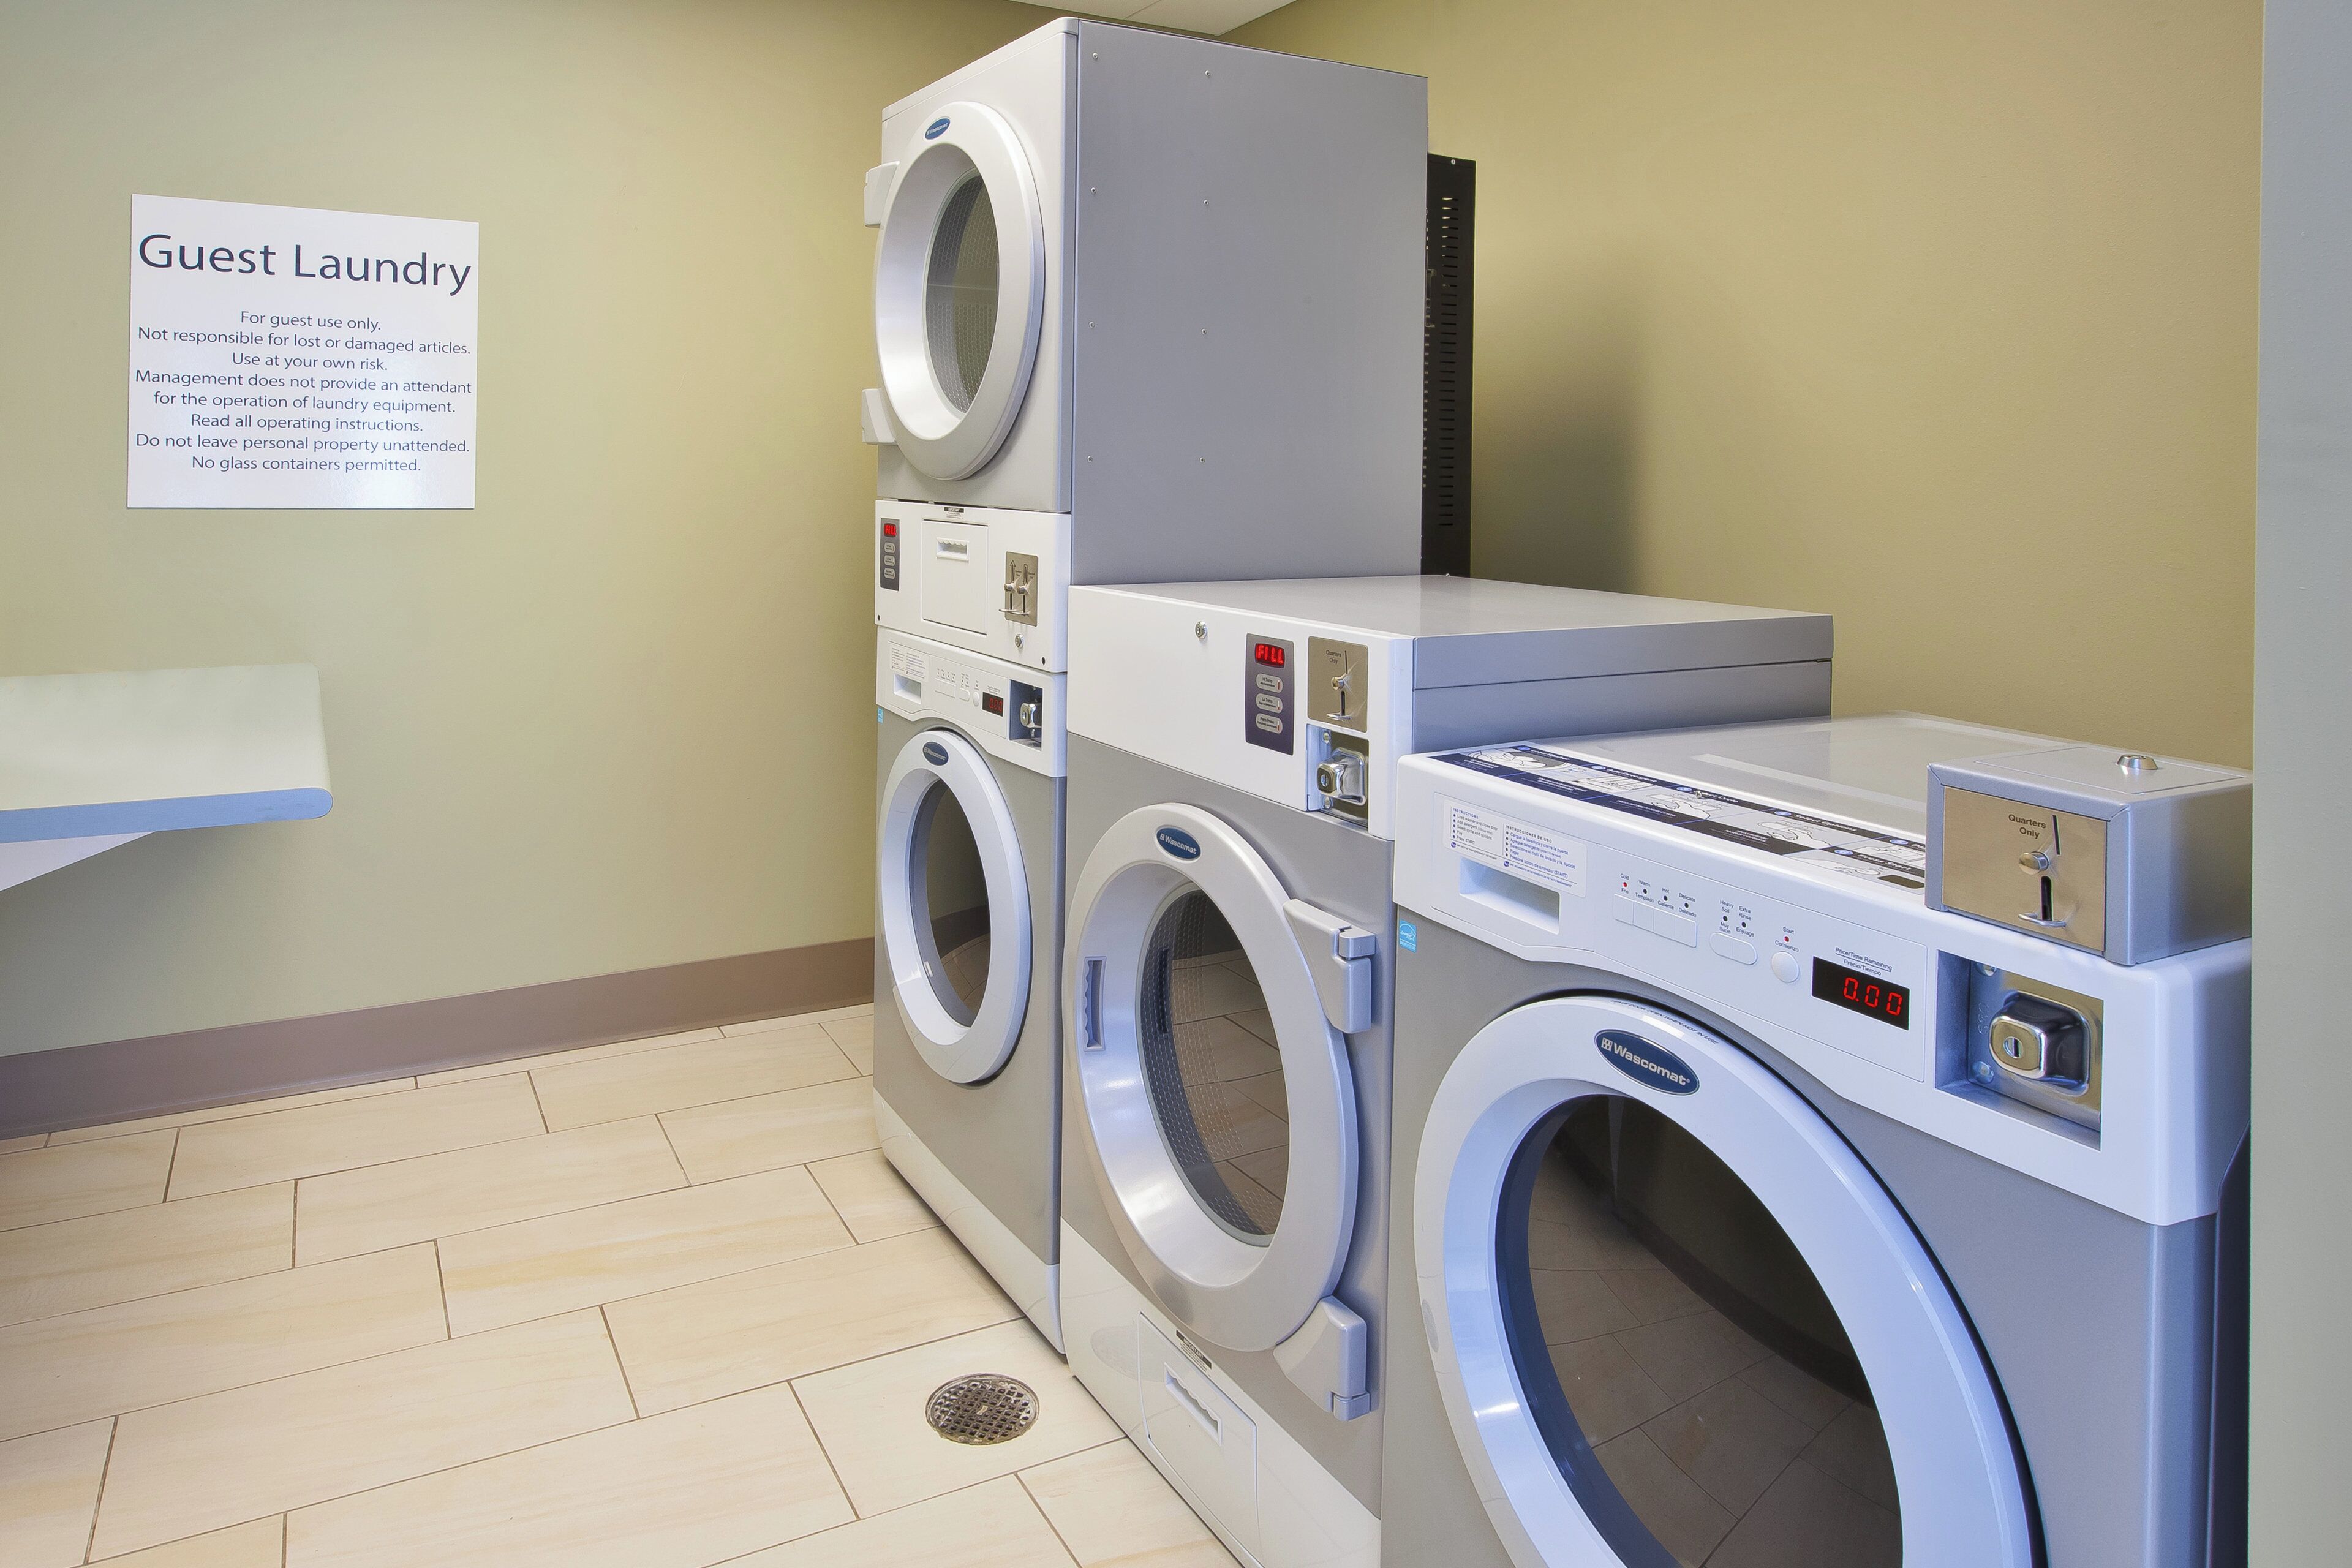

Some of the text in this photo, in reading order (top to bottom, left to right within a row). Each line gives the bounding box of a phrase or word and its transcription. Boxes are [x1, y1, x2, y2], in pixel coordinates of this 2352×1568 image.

[139, 233, 472, 297] Guest Laundry
[241, 311, 381, 333] For guest use only.
[138, 326, 470, 355] Not responsible for lost or damaged articles.
[232, 352, 388, 371] Use at your own risk.
[135, 369, 472, 394] Management does not provide an attendant
[153, 391, 456, 415] for the operation of laundry equipment.
[191, 413, 423, 433] Read all operating instructions.
[137, 433, 470, 454] Do not leave personal property unattended.
[192, 456, 421, 473] No glass containers permitted.
[1257, 644, 1284, 665] FILL
[2008, 814, 2046, 829] Quarters
[2019, 827, 2040, 839] Only
[1165, 835, 1197, 854] Wascomat
[1635, 892, 1654, 903] Templado
[1657, 900, 1674, 910] Caliente
[1679, 892, 1695, 902] Delicate
[1719, 900, 1734, 909] Heavy
[1678, 907, 1697, 918] Delicado
[1774, 940, 1800, 952] Comienzo
[1835, 947, 1893, 972] Price/Time Remaining
[1844, 959, 1882, 976] Precio/Tiempo
[1843, 977, 1902, 1016] 0.00
[1613, 1042, 1687, 1086] Wascomat
